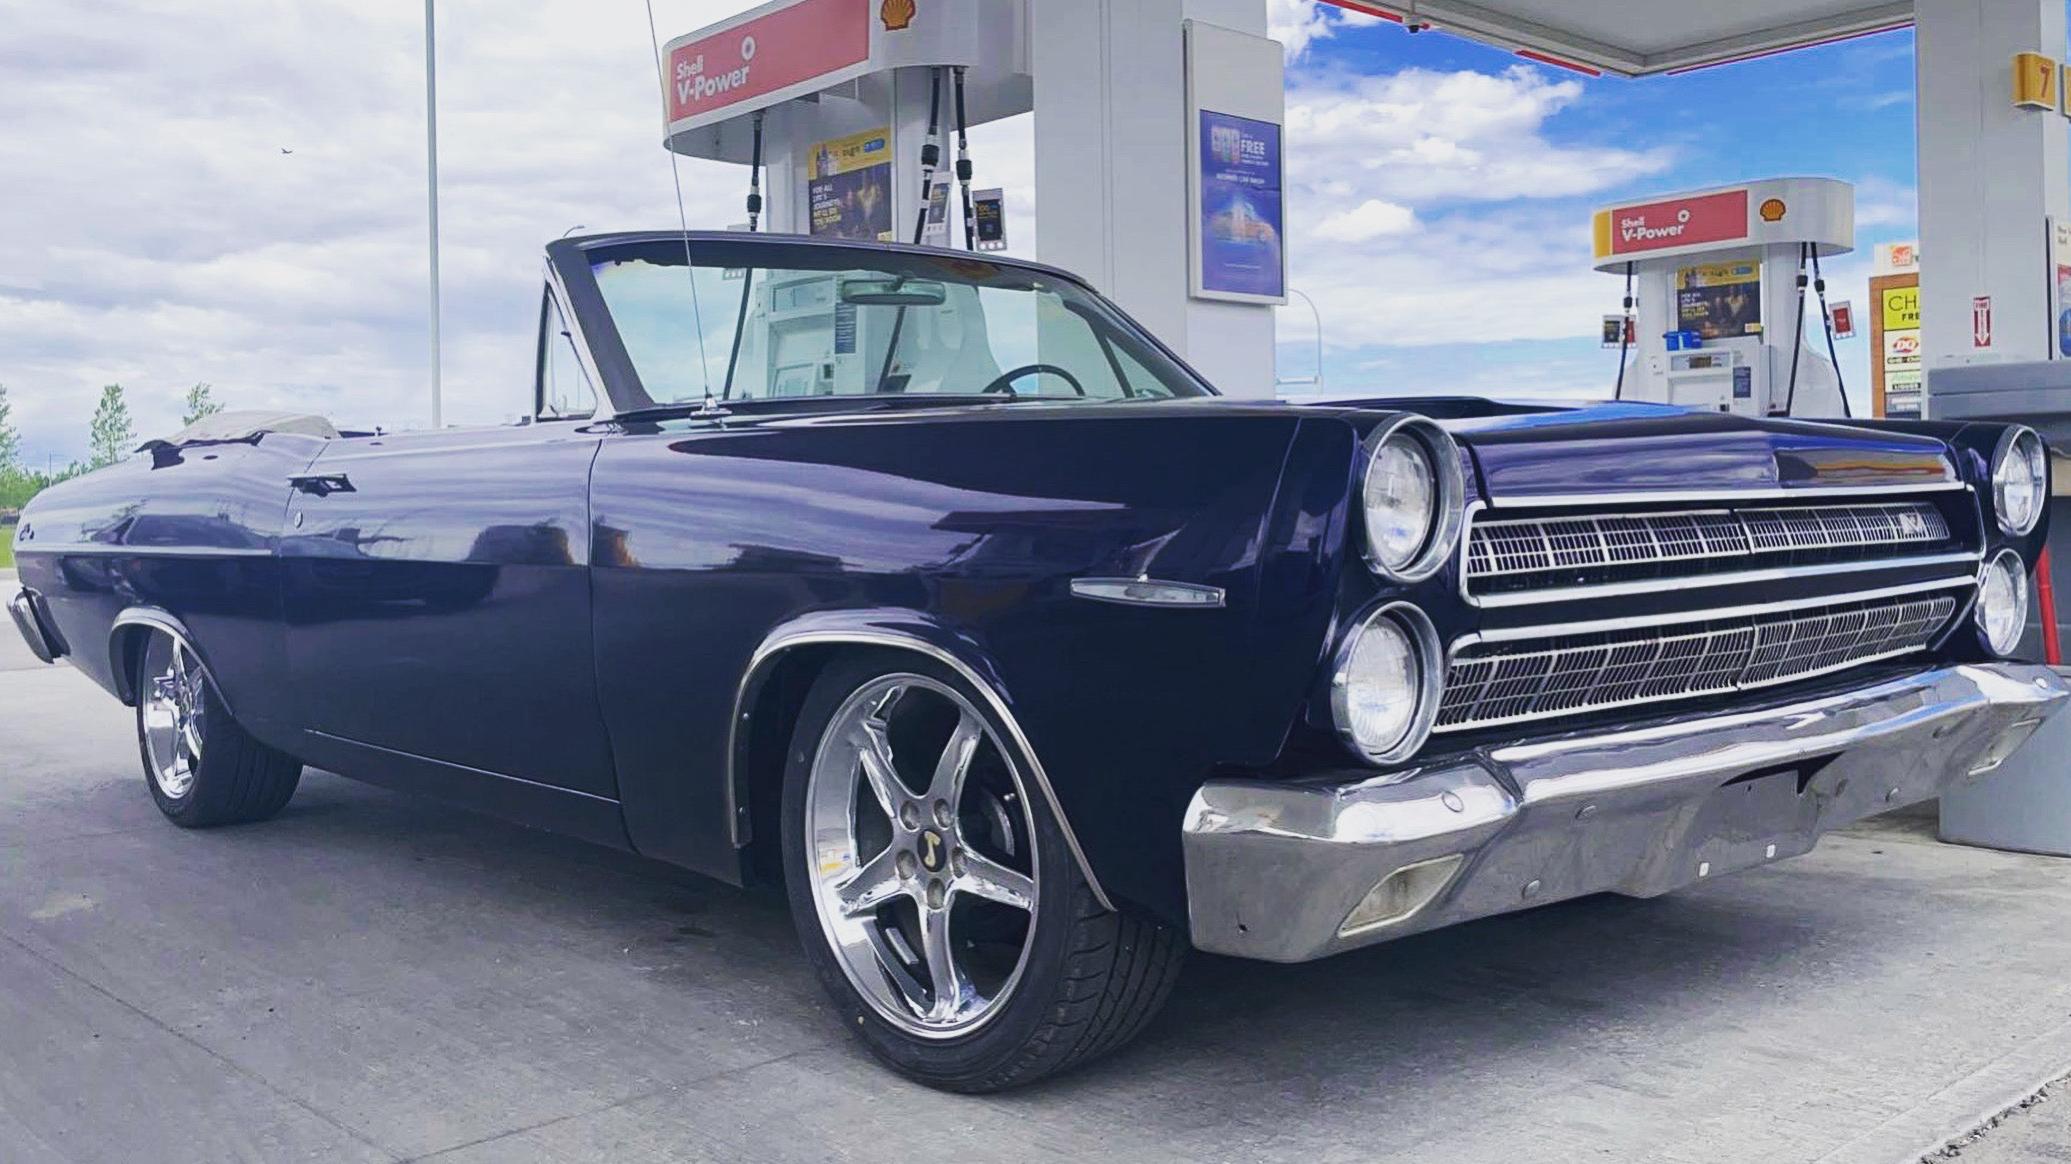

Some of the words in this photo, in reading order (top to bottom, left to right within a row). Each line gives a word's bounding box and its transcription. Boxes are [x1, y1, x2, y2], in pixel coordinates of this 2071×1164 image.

[676, 54, 704, 80] Shell
[677, 66, 750, 104] V-Power
[2040, 64, 2050, 98] 7
[1240, 139, 1265, 156] FREE
[1621, 216, 1645, 229] Shell
[1622, 225, 1684, 242] V-Power
